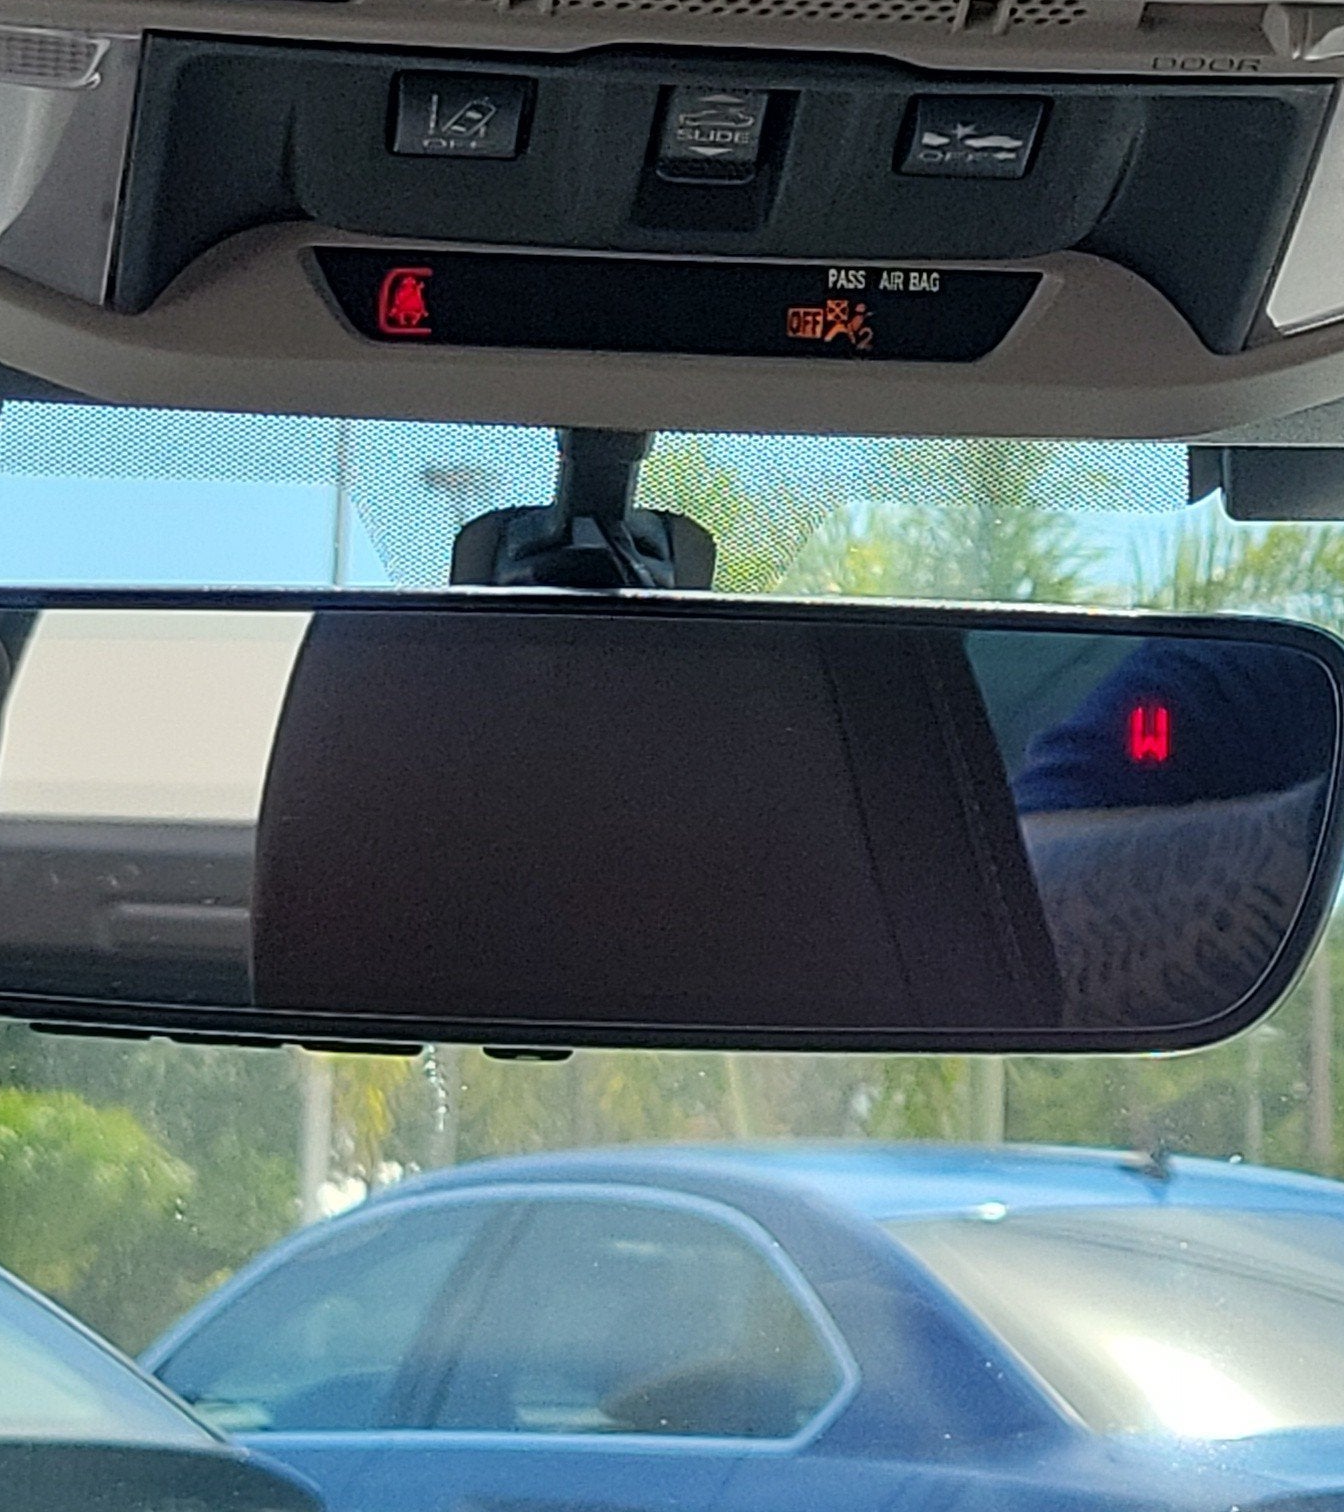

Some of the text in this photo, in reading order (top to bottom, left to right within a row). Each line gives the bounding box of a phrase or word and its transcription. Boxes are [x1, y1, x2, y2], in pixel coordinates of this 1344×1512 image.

[1152, 56, 1260, 72] DOOR
[676, 129, 750, 143] SLIDE
[827, 268, 940, 292] PASS AIR BAG
[790, 310, 822, 336] OFF
[1131, 706, 1169, 761] W
